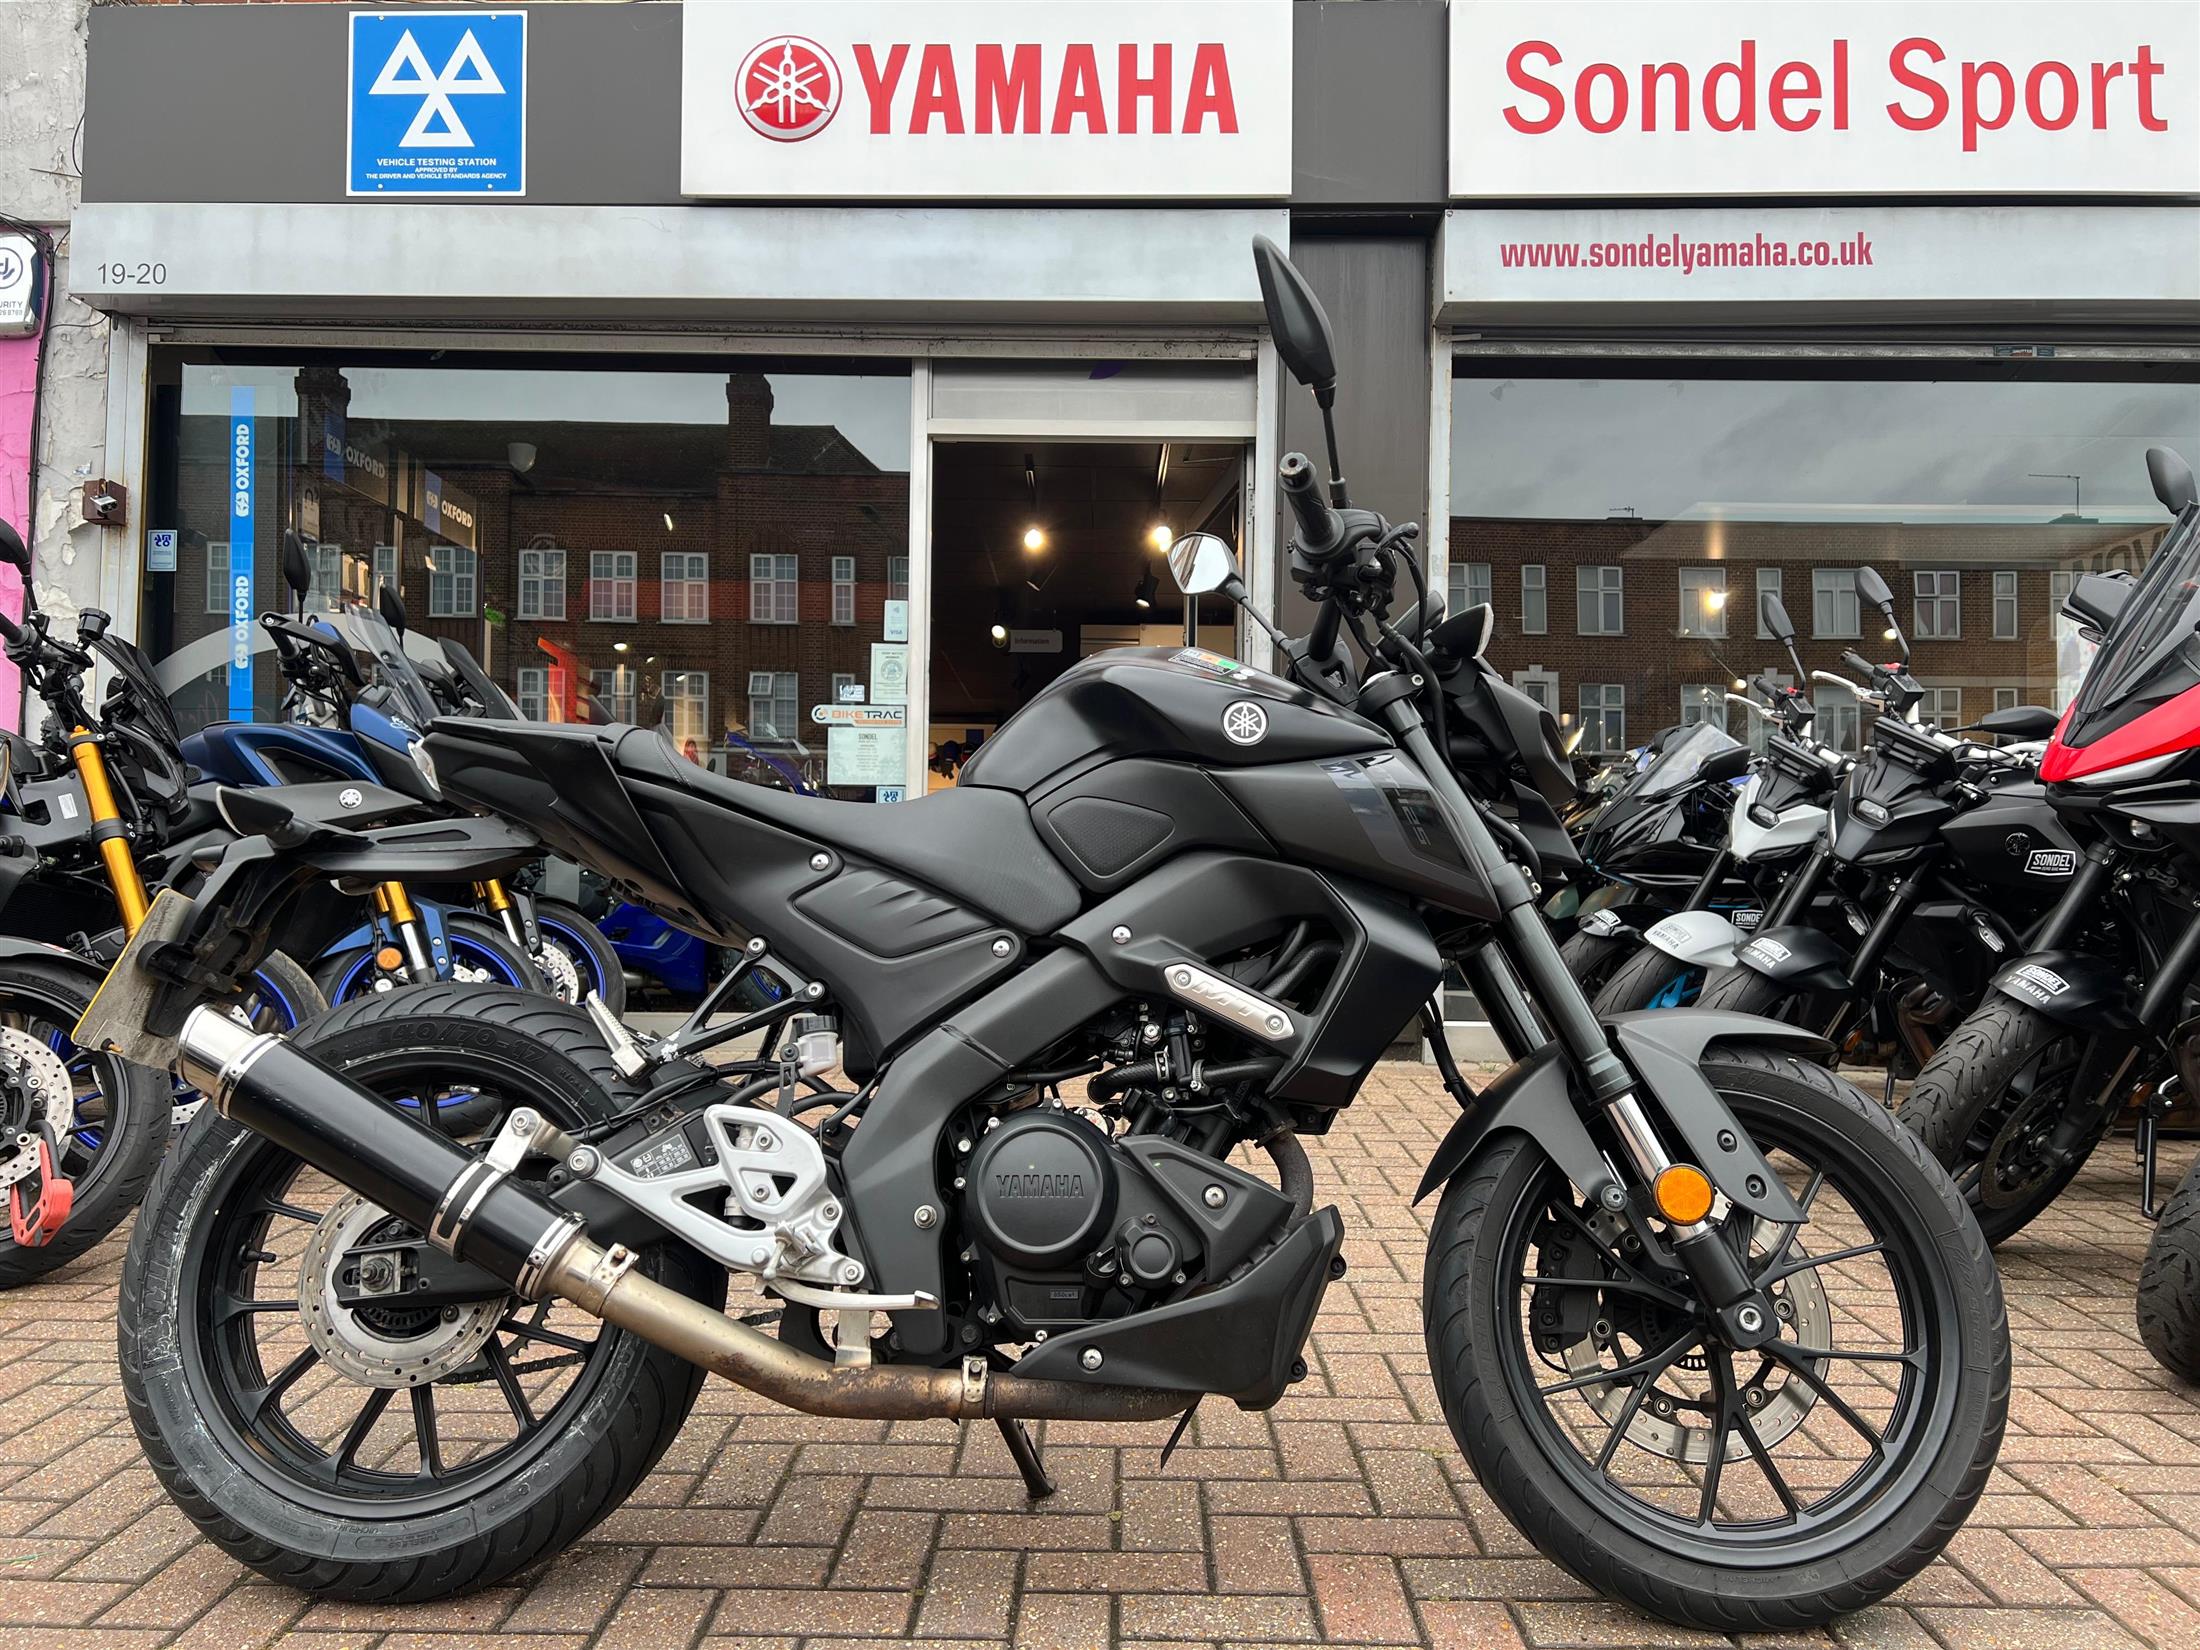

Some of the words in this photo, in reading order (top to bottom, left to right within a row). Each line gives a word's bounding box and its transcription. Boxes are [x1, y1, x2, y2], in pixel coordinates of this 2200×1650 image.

[852, 43, 1239, 135] YAMAHA
[1502, 39, 1850, 135] Sondel
[1886, 37, 2168, 152] Sport
[377, 158, 416, 166] VEHICLE
[417, 158, 456, 166] TESTING
[457, 158, 497, 166] STATION
[1501, 232, 1873, 274] www.sondelyamaha.co.uk
[97, 263, 167, 285] 19-20
[235, 424, 249, 490] OXFORD
[346, 446, 385, 479] OXFORD
[441, 500, 473, 528] OXFORD
[234, 575, 248, 641] OXFORD
[832, 710, 902, 720] BIKETRAC
[2032, 854, 2071, 867] SONDEL
[1735, 913, 1763, 923] SONDE
[1742, 946, 1776, 969] YAMAHA
[2004, 975, 2052, 1005] YAMAHA
[995, 1174, 1084, 1199] YAMAHA
